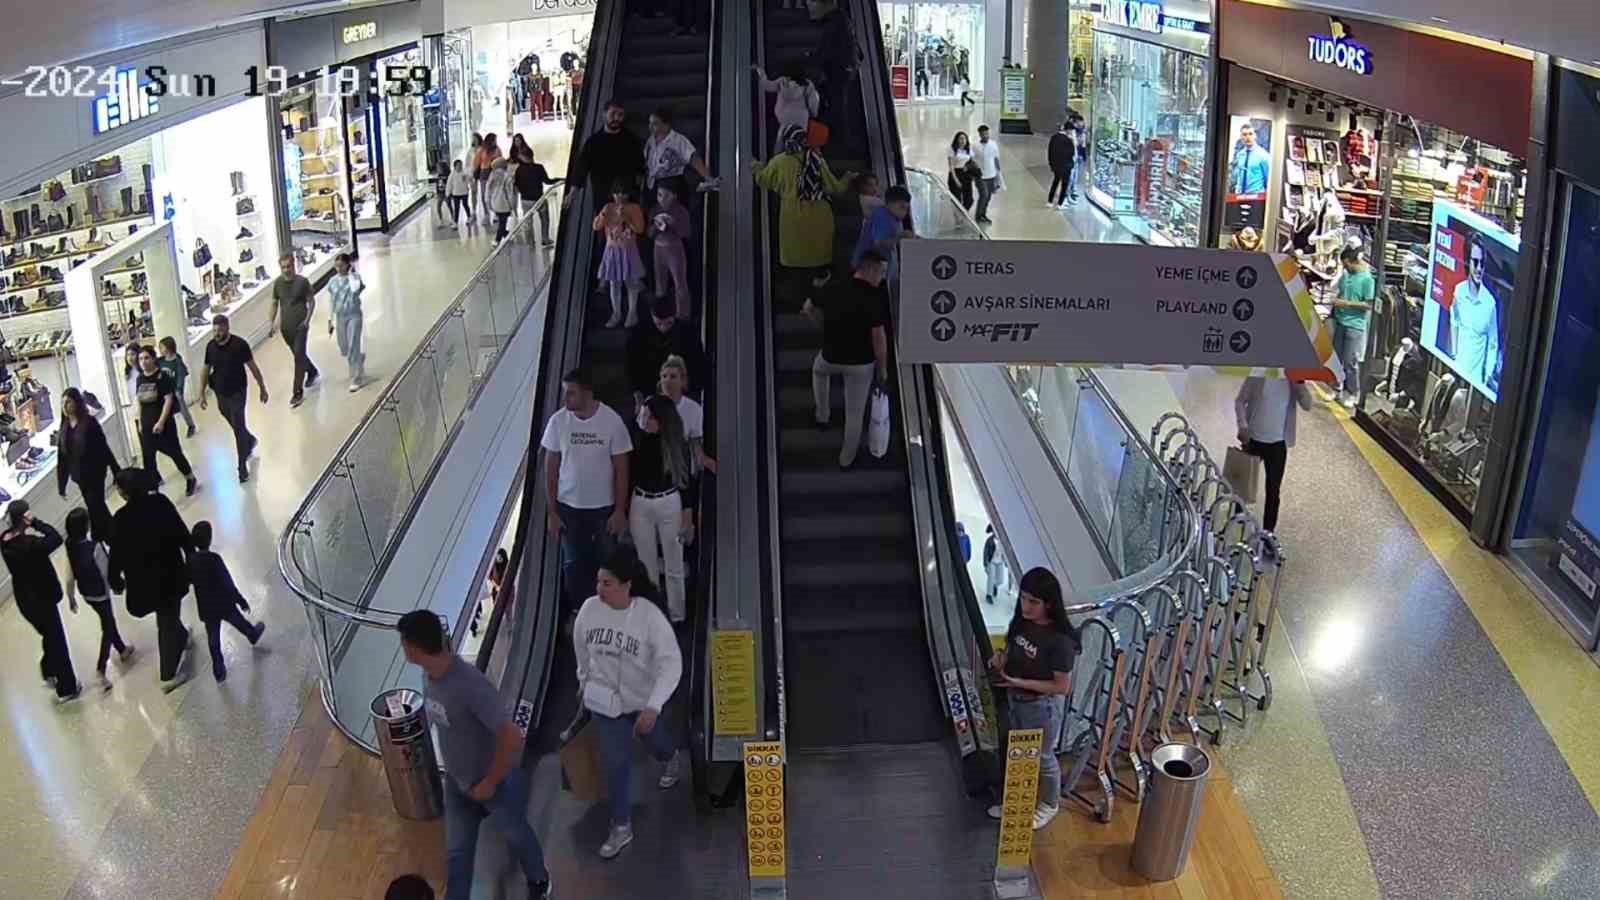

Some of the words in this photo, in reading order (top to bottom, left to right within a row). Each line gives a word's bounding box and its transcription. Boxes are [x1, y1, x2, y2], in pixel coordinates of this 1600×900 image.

[1308, 36, 1367, 75] TUDORS
[966, 261, 1015, 275] TERAS
[1155, 266, 1193, 281] YEME
[1197, 266, 1231, 283] İÇME
[964, 296, 1015, 312] AVŞAR
[1020, 294, 1110, 310] SİNEMALARI
[1156, 300, 1227, 315] PLAYLAND
[585, 627, 614, 646] WILD
